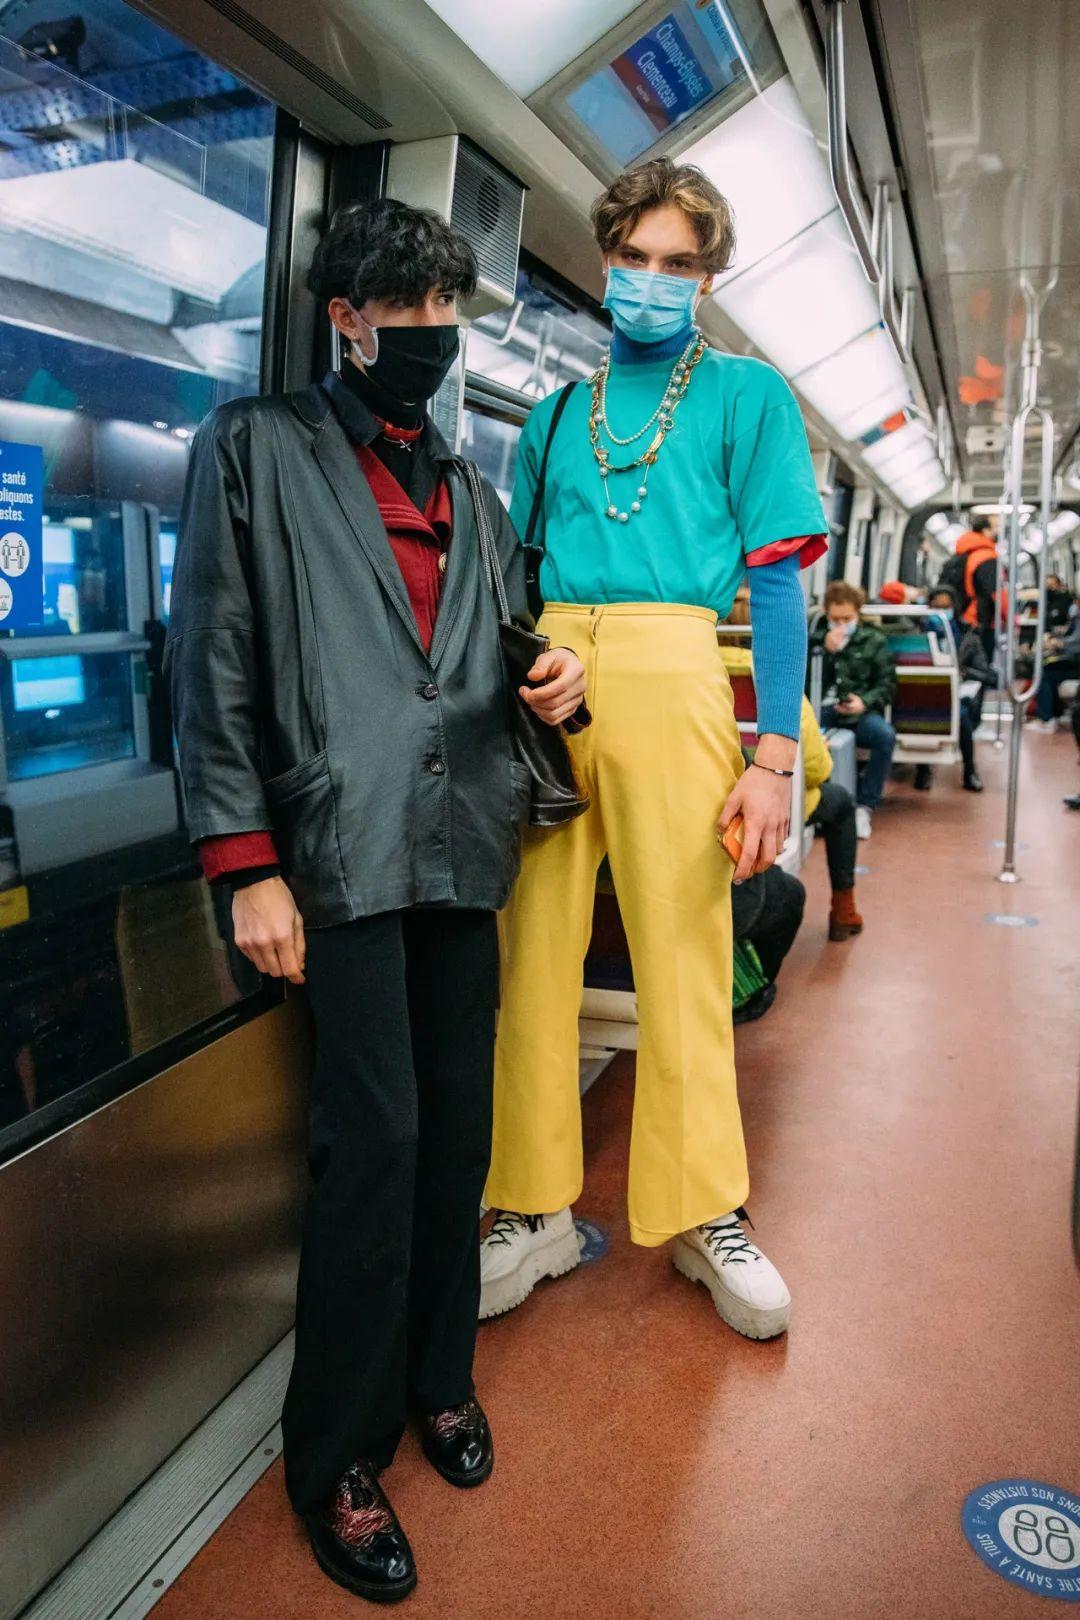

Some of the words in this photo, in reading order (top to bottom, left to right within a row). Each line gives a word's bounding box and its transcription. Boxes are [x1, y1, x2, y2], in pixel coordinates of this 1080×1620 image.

[637, 51, 679, 108] Clemenceau
[2, 471, 26, 486] santé
[978, 1486, 1029, 1510] DISTANCES
[1032, 1487, 1055, 1502] NOS
[976, 1533, 1001, 1558] TOUS
[1010, 1563, 1053, 1589] SANTÉ
